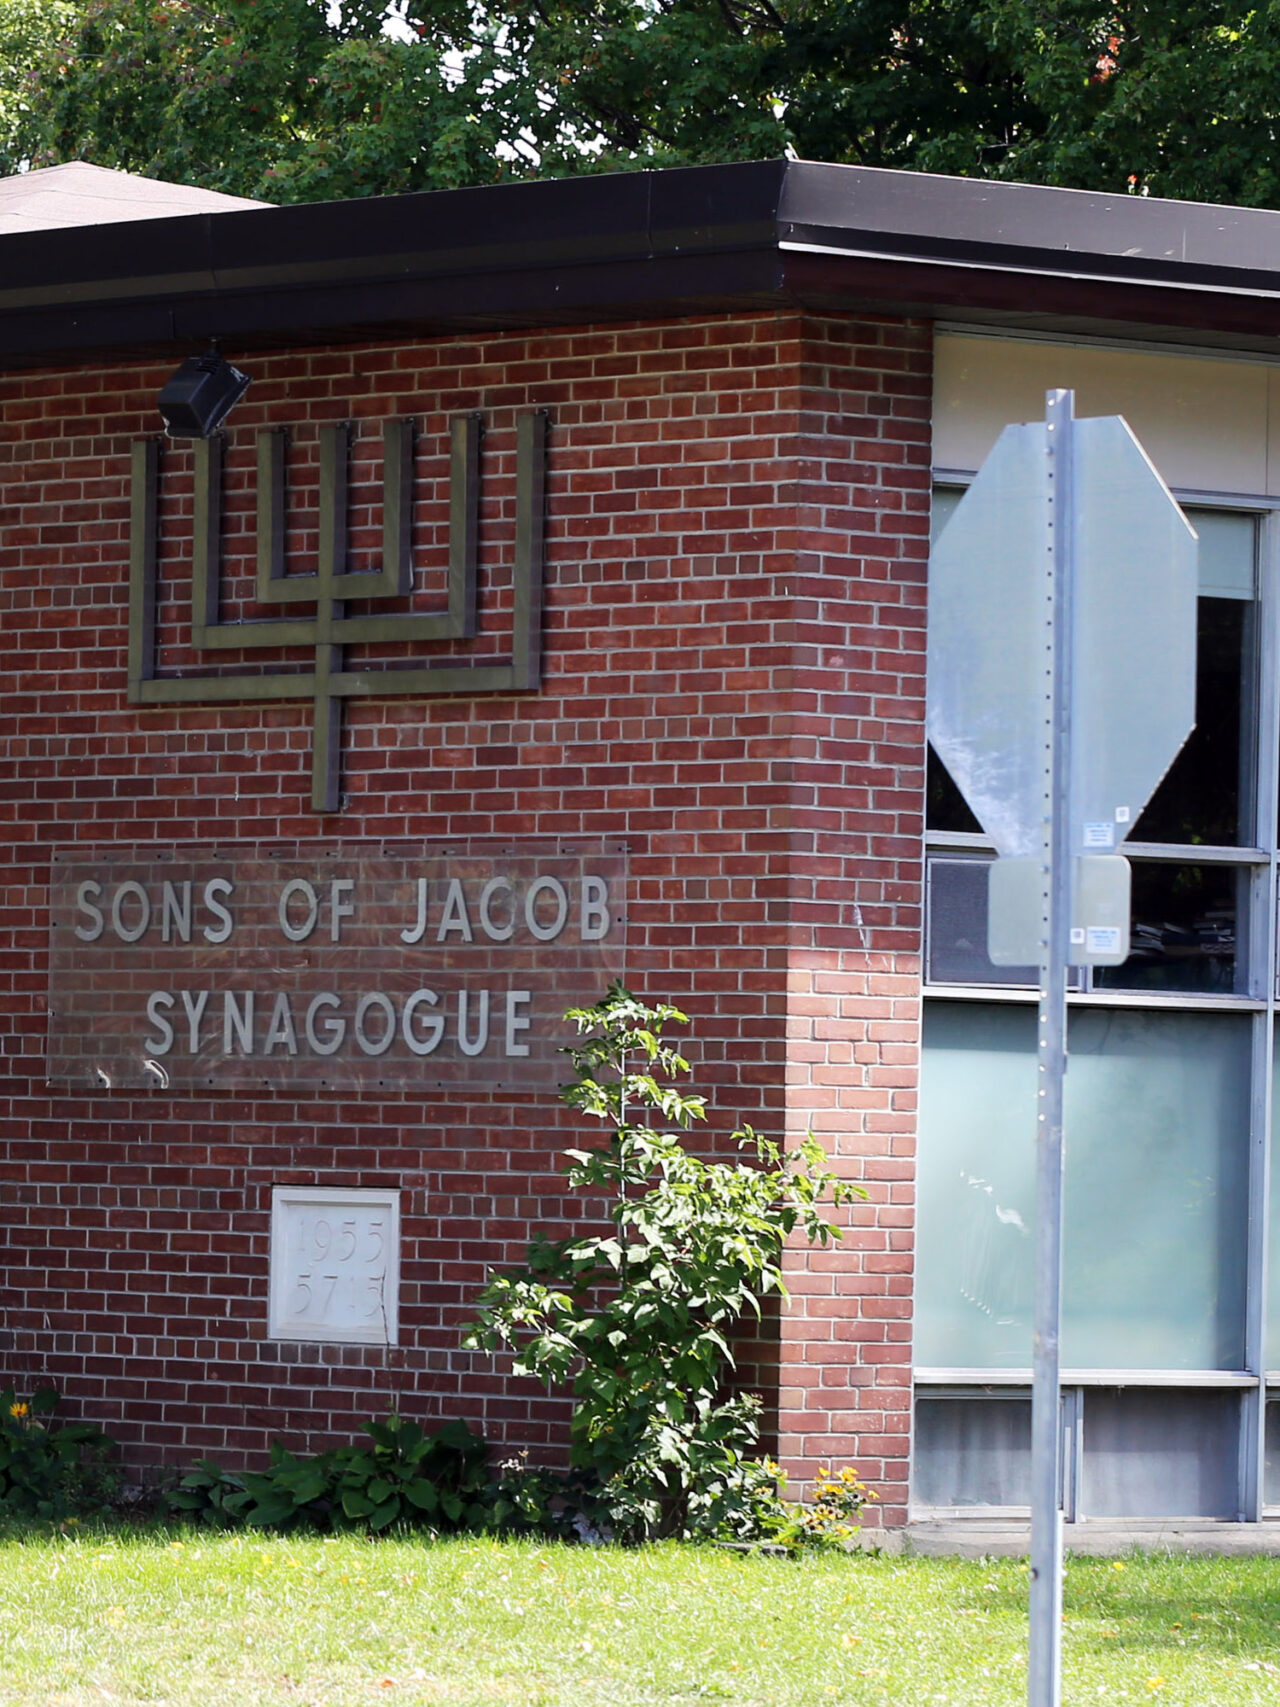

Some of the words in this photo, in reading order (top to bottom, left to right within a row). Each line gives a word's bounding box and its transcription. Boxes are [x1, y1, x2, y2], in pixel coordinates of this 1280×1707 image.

[74, 877, 234, 944] SONS
[278, 877, 355, 943] OF
[401, 875, 610, 944] JACOB
[145, 988, 532, 1057] SYNAGOGUE
[297, 1219, 385, 1264] 1955
